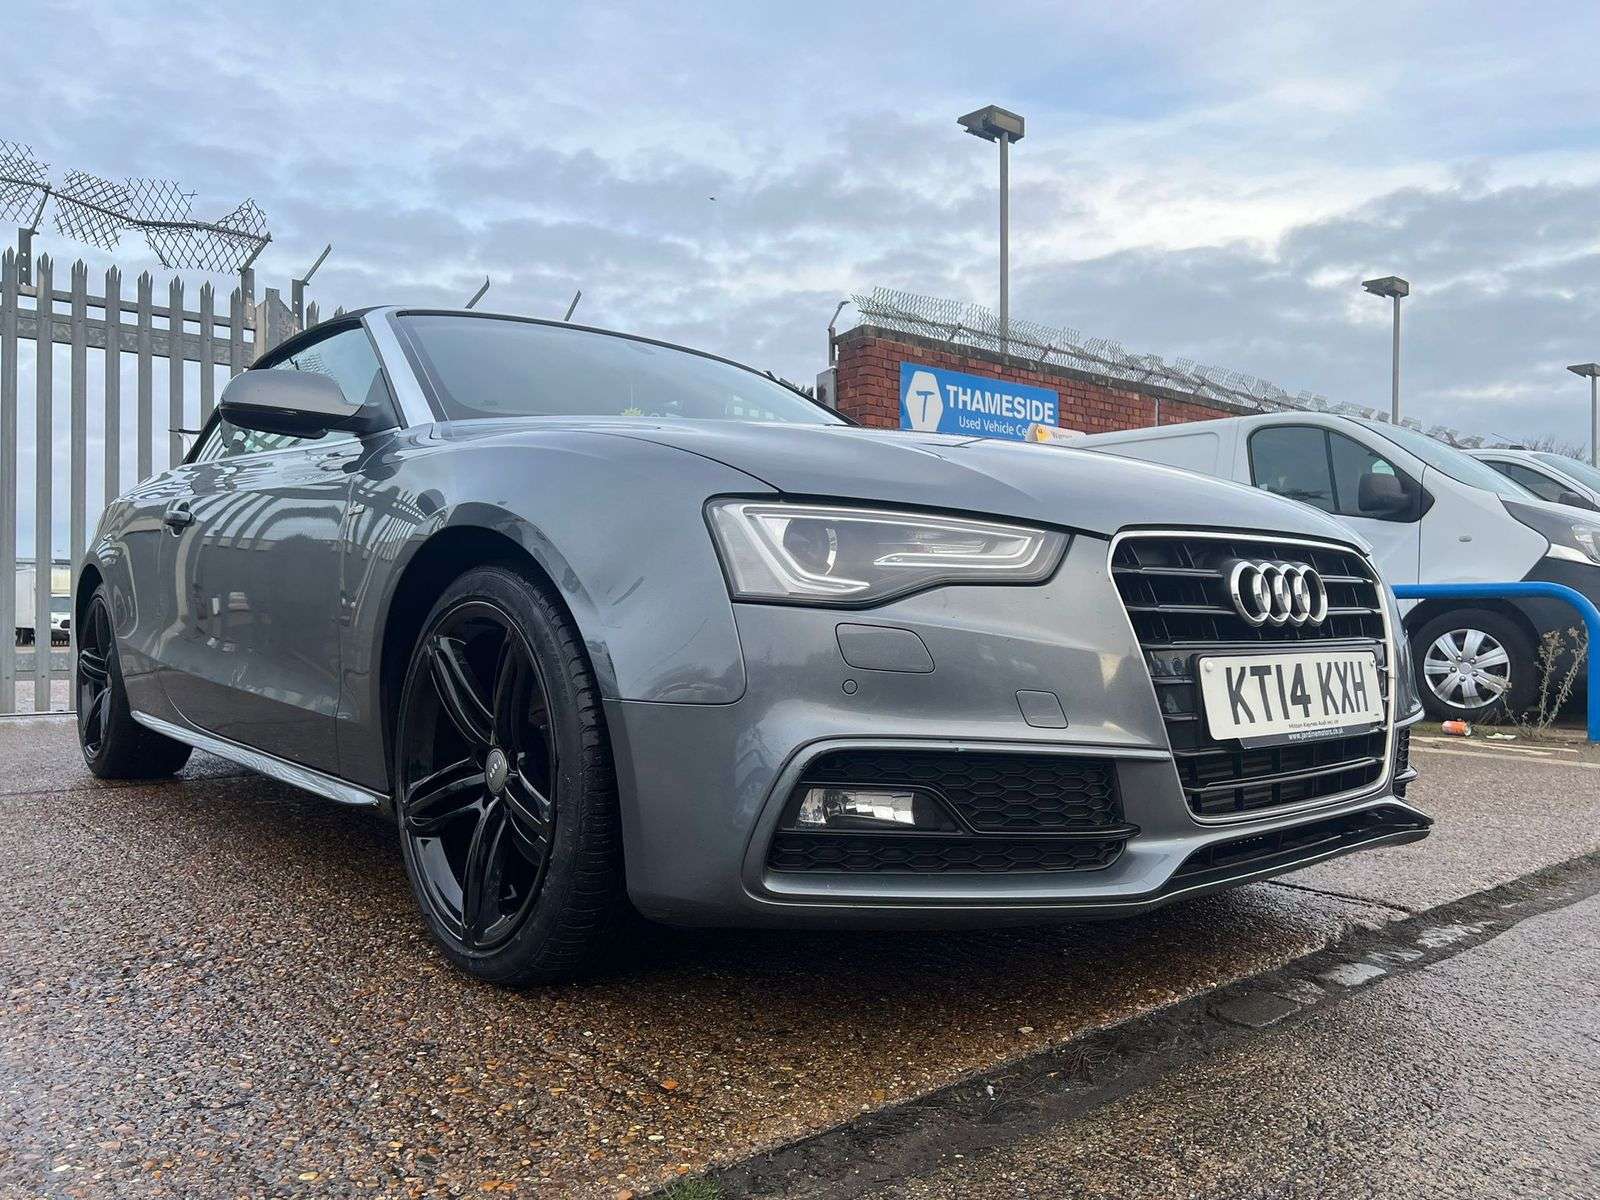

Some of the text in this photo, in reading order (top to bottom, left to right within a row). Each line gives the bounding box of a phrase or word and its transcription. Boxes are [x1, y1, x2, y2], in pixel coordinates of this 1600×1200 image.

[946, 384, 1055, 424] THAMESIDE
[959, 415, 1030, 437] Used Vehicle Ce
[1225, 661, 1369, 725] KT14 KXH
